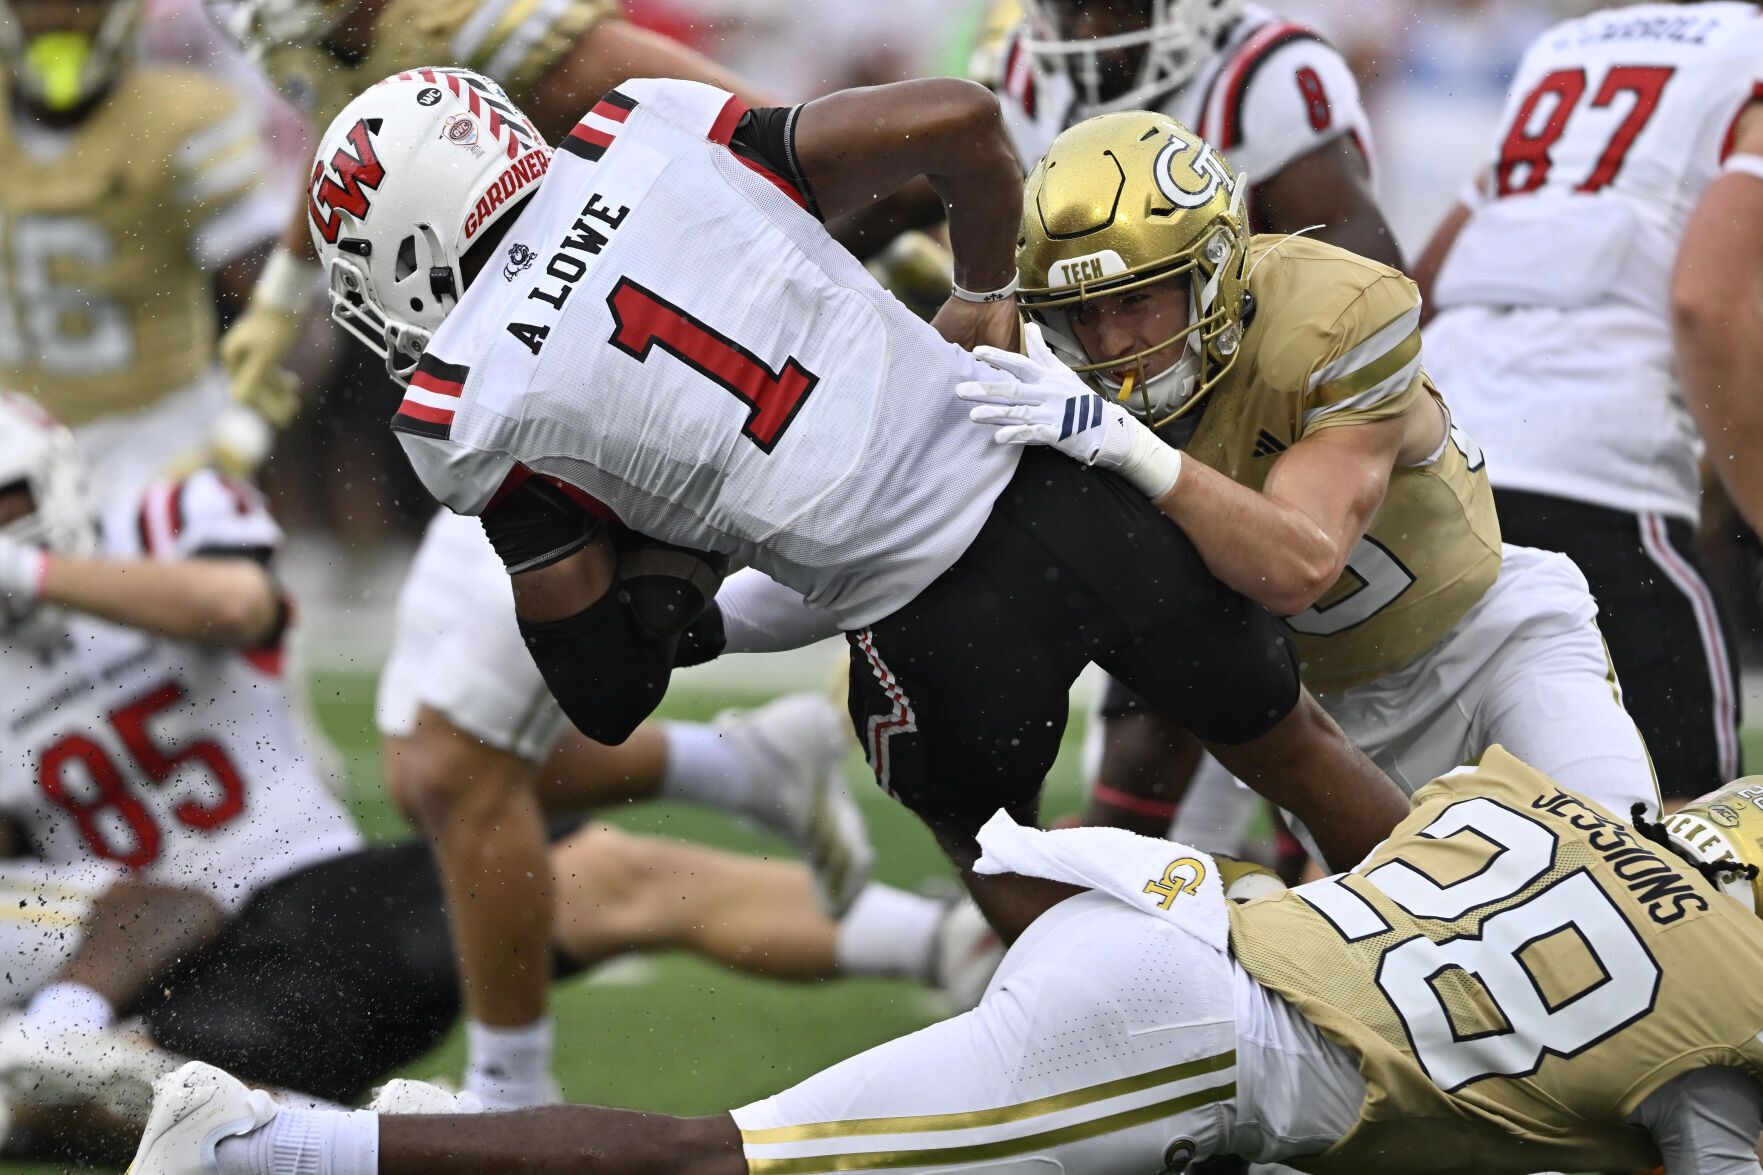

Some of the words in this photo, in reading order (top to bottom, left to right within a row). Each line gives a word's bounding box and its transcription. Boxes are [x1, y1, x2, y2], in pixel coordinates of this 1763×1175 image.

[420, 89, 441, 105] WC
[1295, 66, 1331, 131] 8
[1496, 65, 1677, 196] 87
[0, 212, 135, 376] 6
[527, 193, 631, 311] LOWE
[1061, 257, 1104, 285] TECH
[506, 322, 551, 356] A
[606, 275, 820, 455] 1
[38, 680, 247, 870] 85
[1710, 807, 1737, 823] ACC
[1143, 857, 1206, 910] GT
[1289, 796, 1663, 1094] 28
